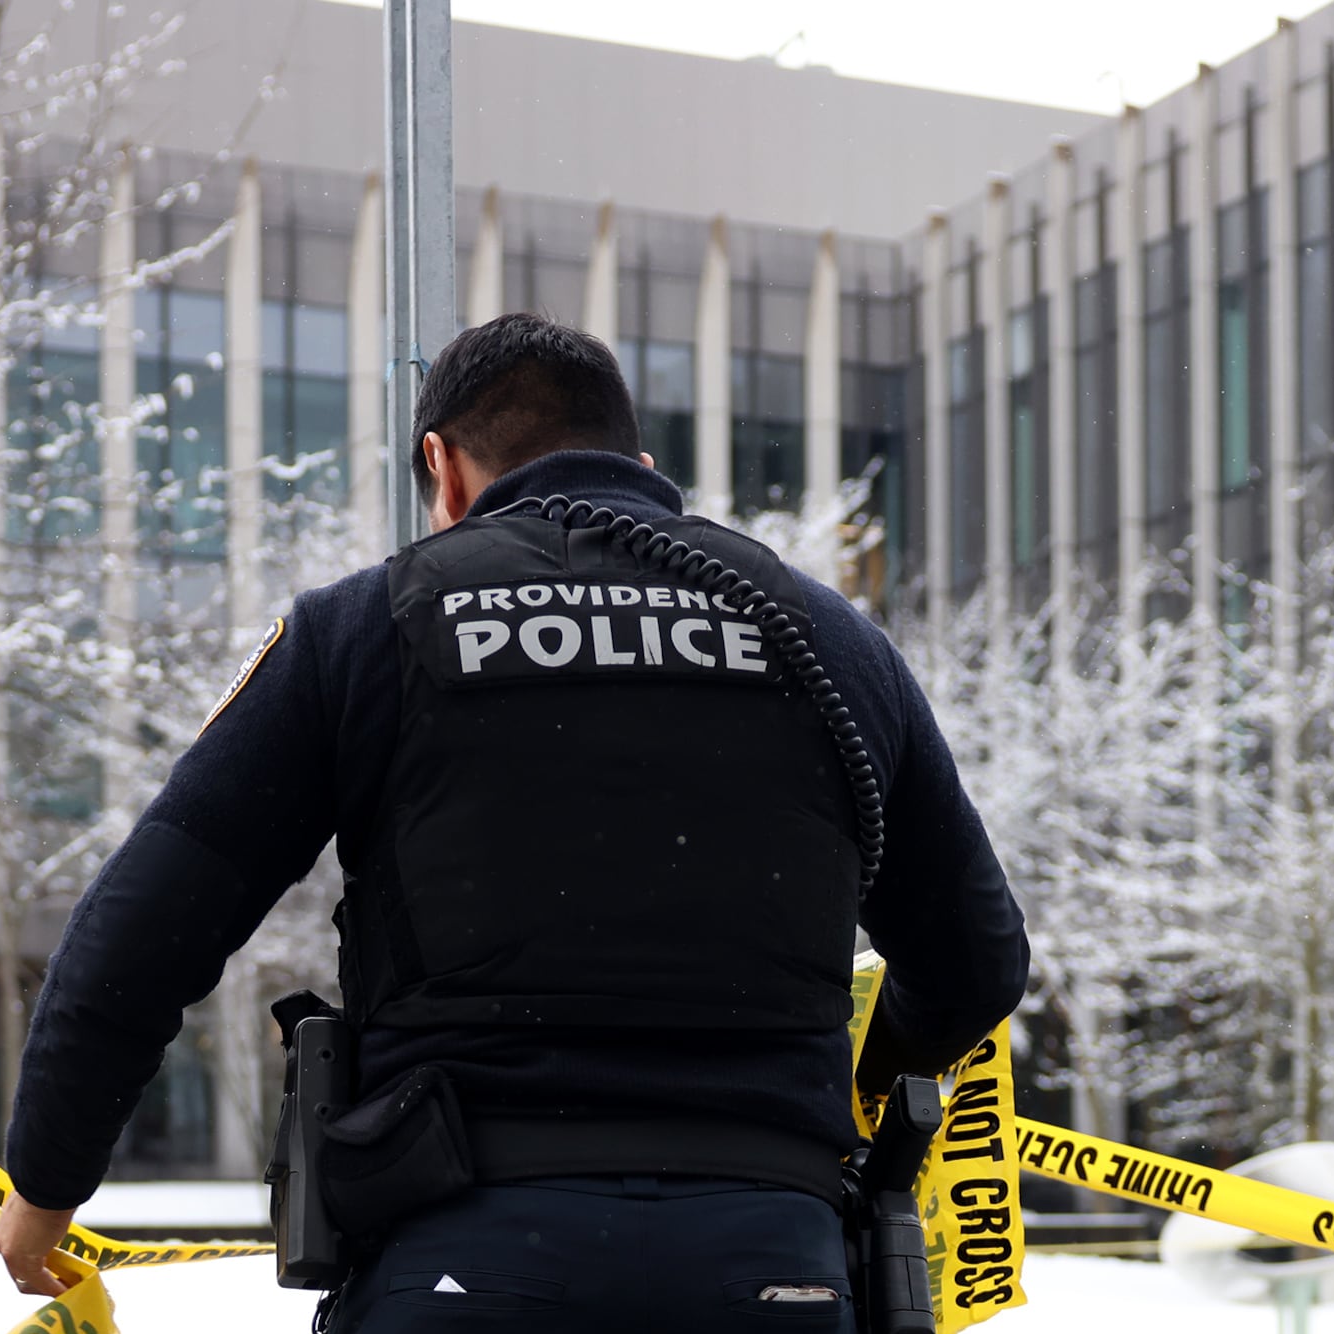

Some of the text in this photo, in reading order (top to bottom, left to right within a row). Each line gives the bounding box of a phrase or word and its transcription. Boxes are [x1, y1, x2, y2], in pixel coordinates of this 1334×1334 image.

[442, 584, 755, 616] PROVIDENC
[455, 615, 768, 673] POLICE
[942, 1077, 1004, 1163] NOT
[951, 1179, 1014, 1309] CROSS
